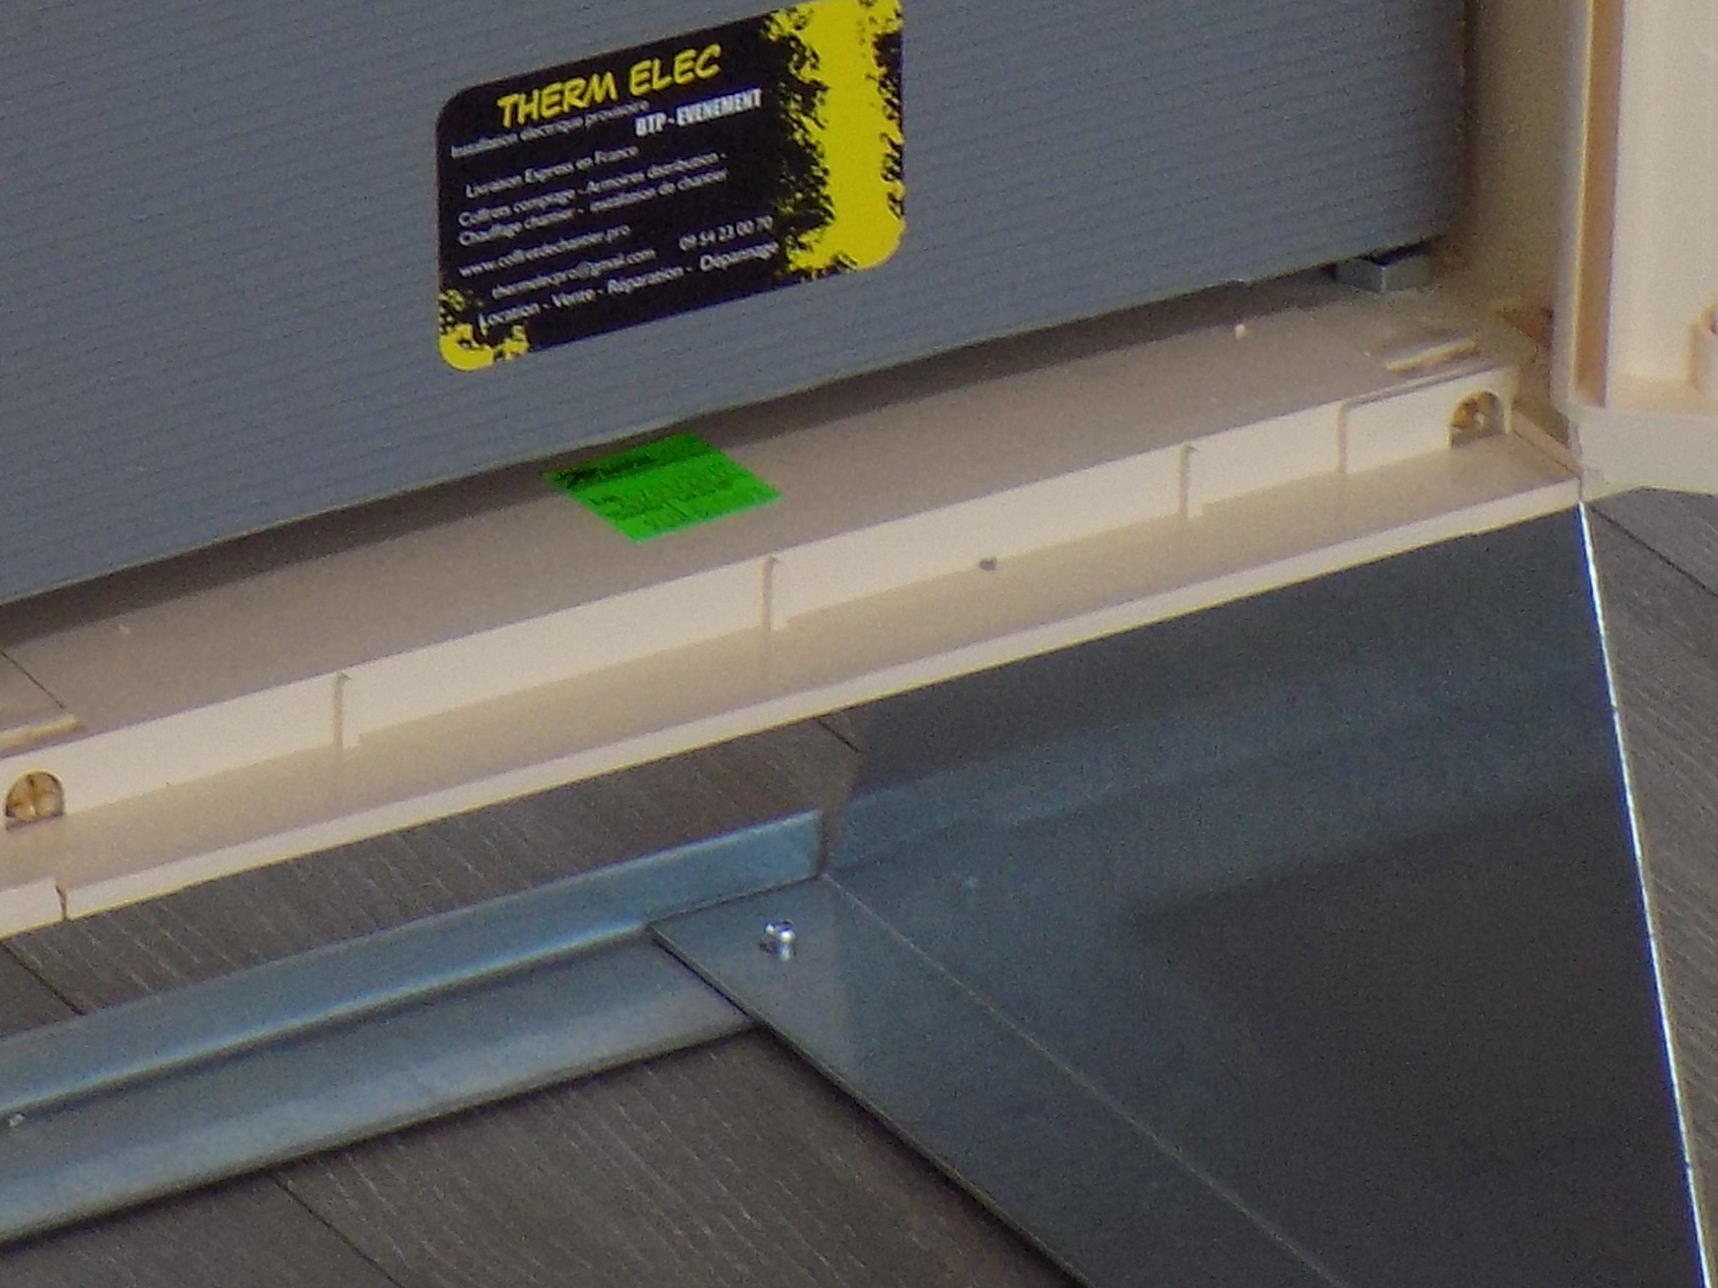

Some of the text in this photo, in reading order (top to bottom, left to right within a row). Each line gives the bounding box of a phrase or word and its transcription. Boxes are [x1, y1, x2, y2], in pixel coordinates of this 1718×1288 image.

[496, 43, 723, 129] THERM ELEC
[676, 88, 763, 126] EVENEMENT
